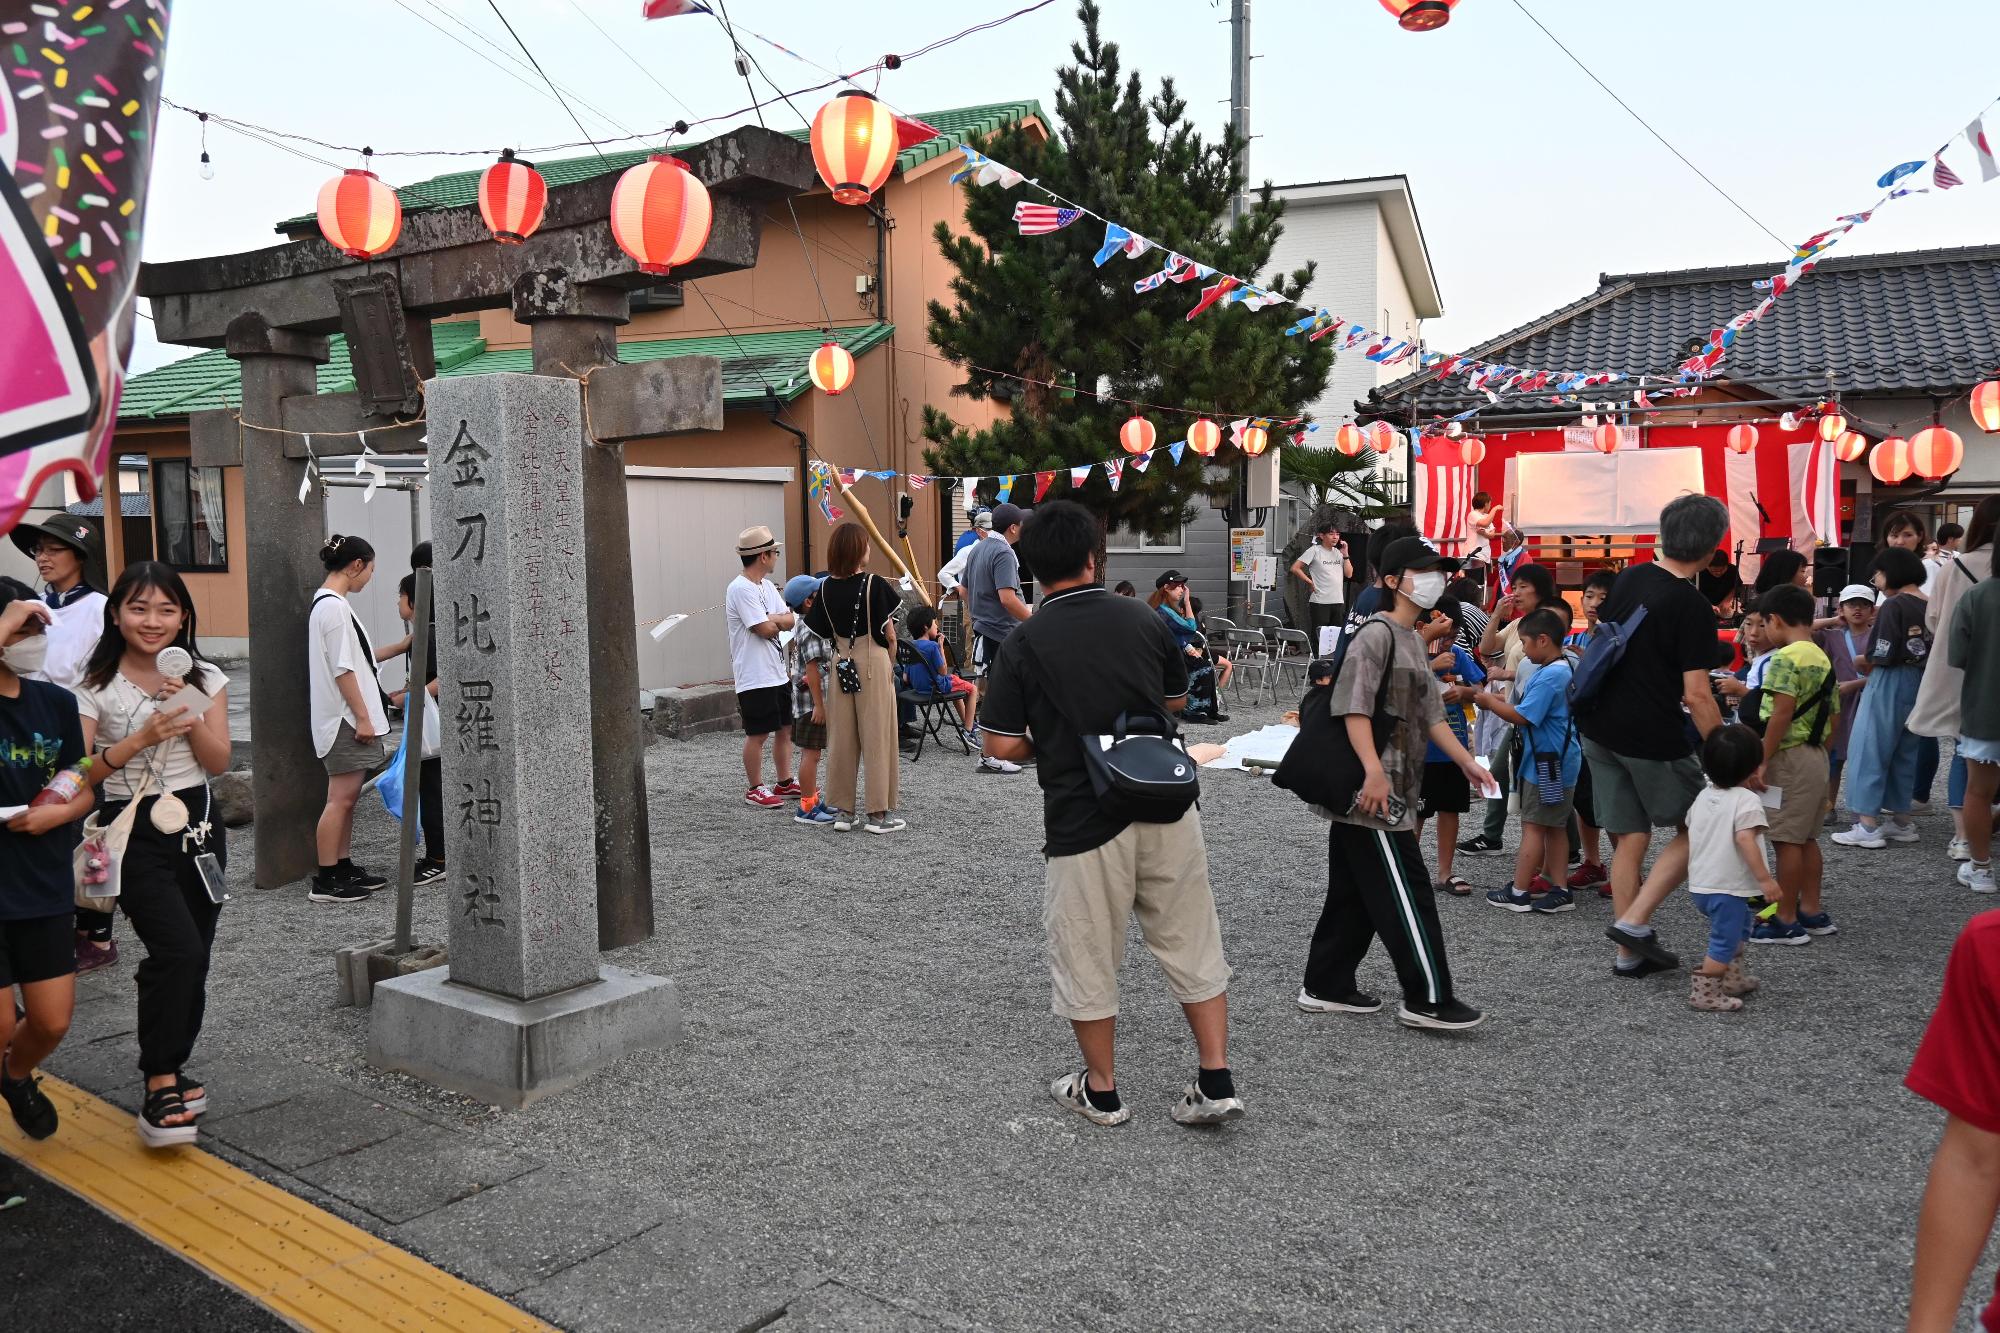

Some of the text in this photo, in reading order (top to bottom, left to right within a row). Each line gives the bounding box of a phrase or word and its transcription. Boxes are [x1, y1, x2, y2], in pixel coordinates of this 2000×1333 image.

[443, 418, 506, 930] 金刀比羅神社
[543, 650, 564, 691] 記念
